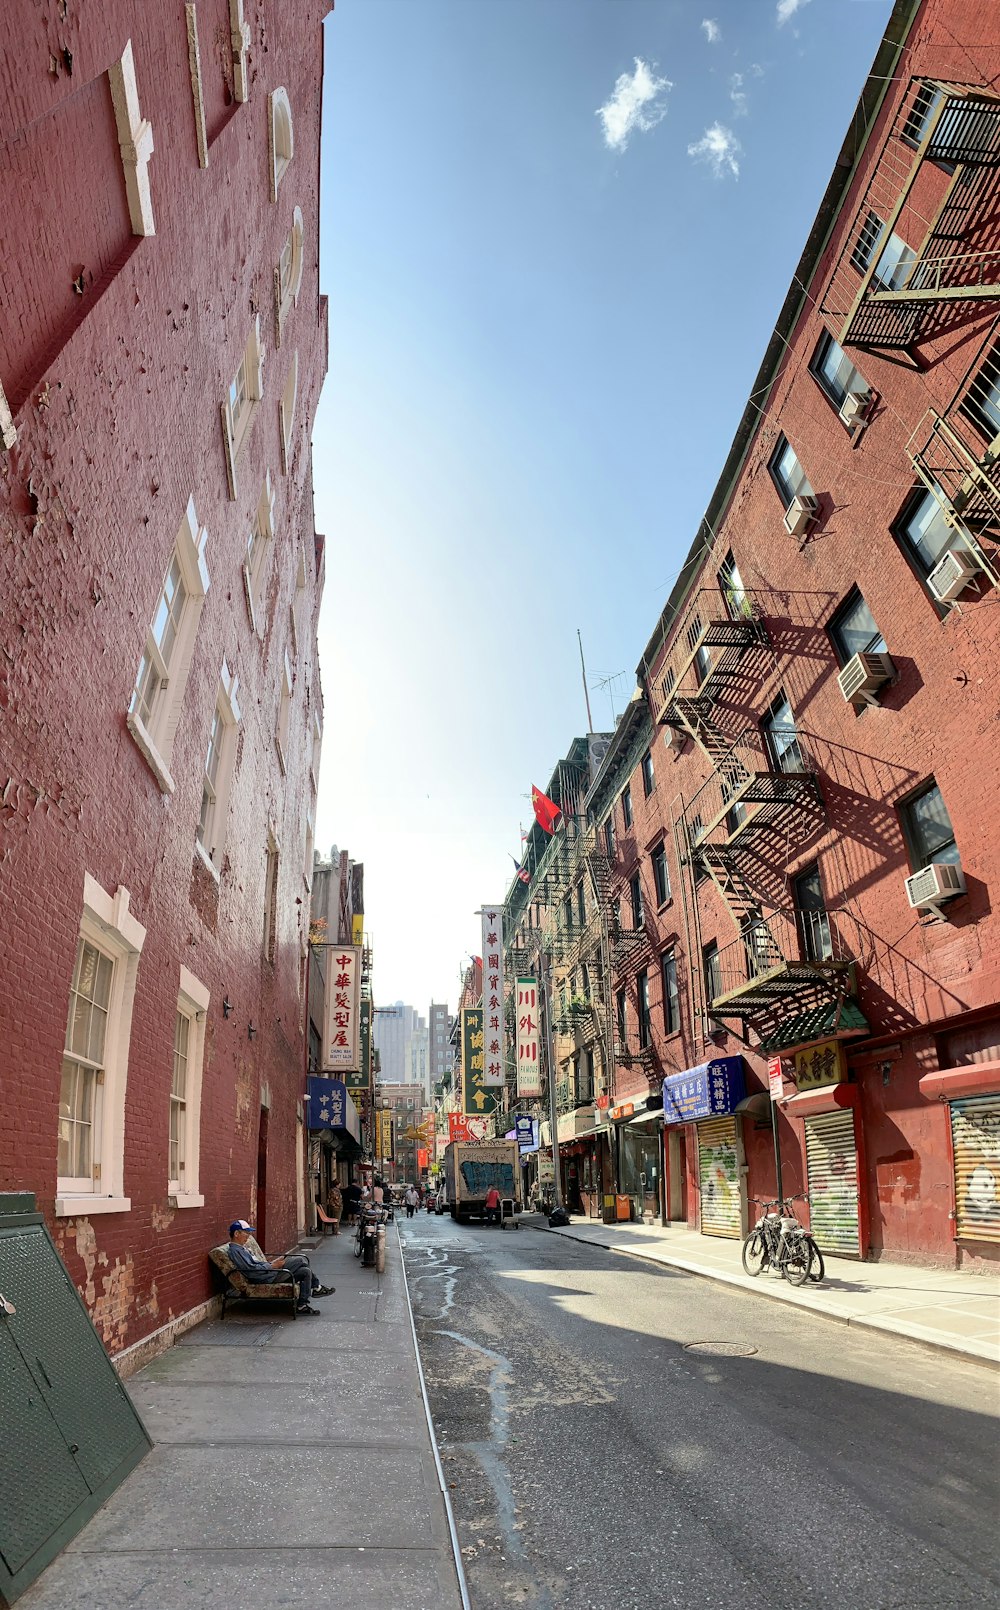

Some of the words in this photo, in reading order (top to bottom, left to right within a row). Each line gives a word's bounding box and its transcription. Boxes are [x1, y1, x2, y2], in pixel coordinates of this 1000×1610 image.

[331, 955, 352, 1047] 中華髮型屋
[519, 988, 538, 1061] 川外川
[451, 1115, 467, 1126] 18
